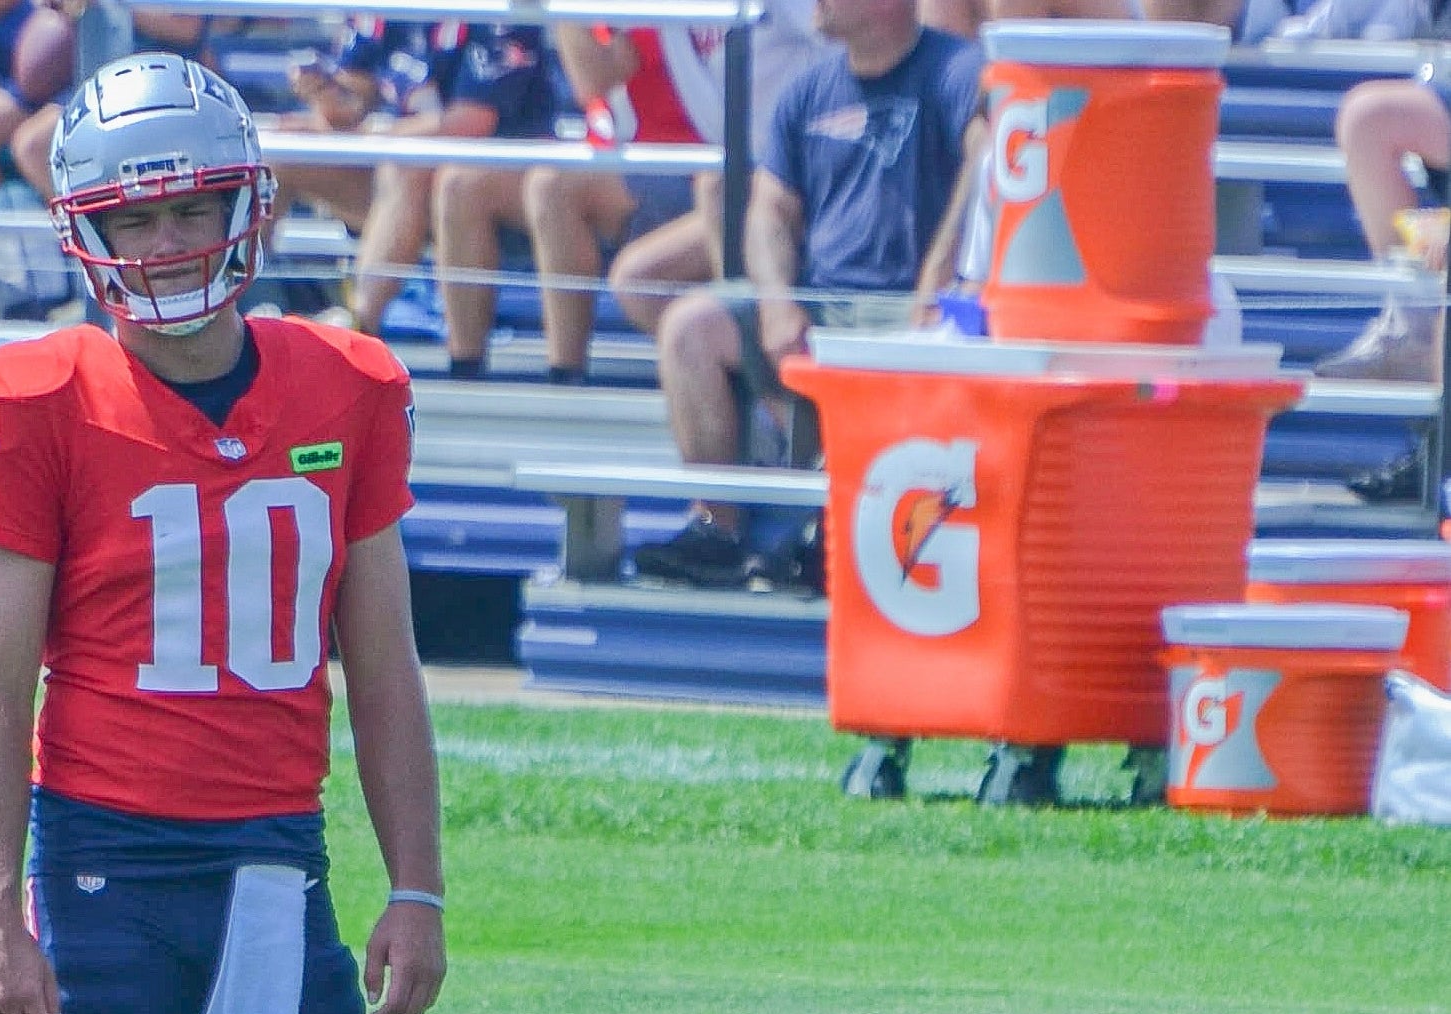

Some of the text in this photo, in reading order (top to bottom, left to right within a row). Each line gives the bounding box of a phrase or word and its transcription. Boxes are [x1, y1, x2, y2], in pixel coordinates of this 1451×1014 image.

[995, 99, 1048, 201] G
[298, 450, 341, 465] Gillette
[130, 476, 334, 693] 10
[854, 435, 982, 637] G
[1185, 679, 1228, 744] G
